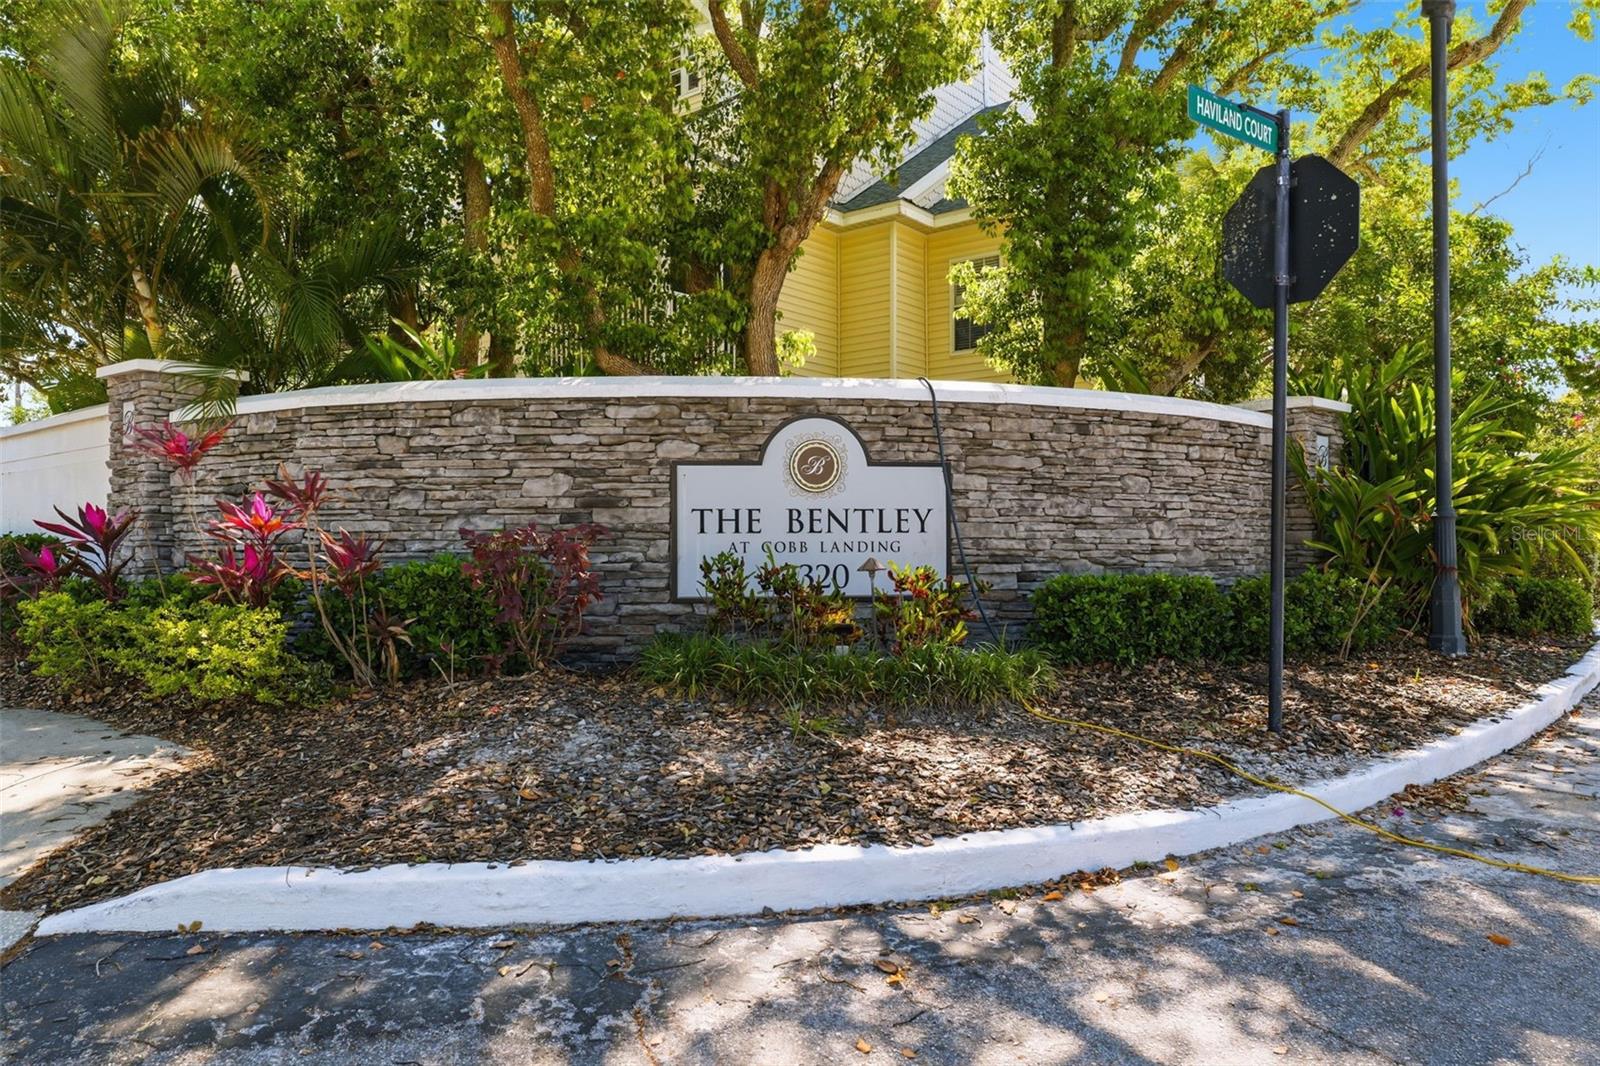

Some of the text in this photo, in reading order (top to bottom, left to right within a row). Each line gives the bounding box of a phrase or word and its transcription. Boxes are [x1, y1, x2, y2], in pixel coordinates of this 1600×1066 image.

[1196, 95, 1273, 145] HAVILAND COURT
[691, 508, 933, 534] THE BENTLEY
[728, 540, 901, 553] AT COBB LANDING
